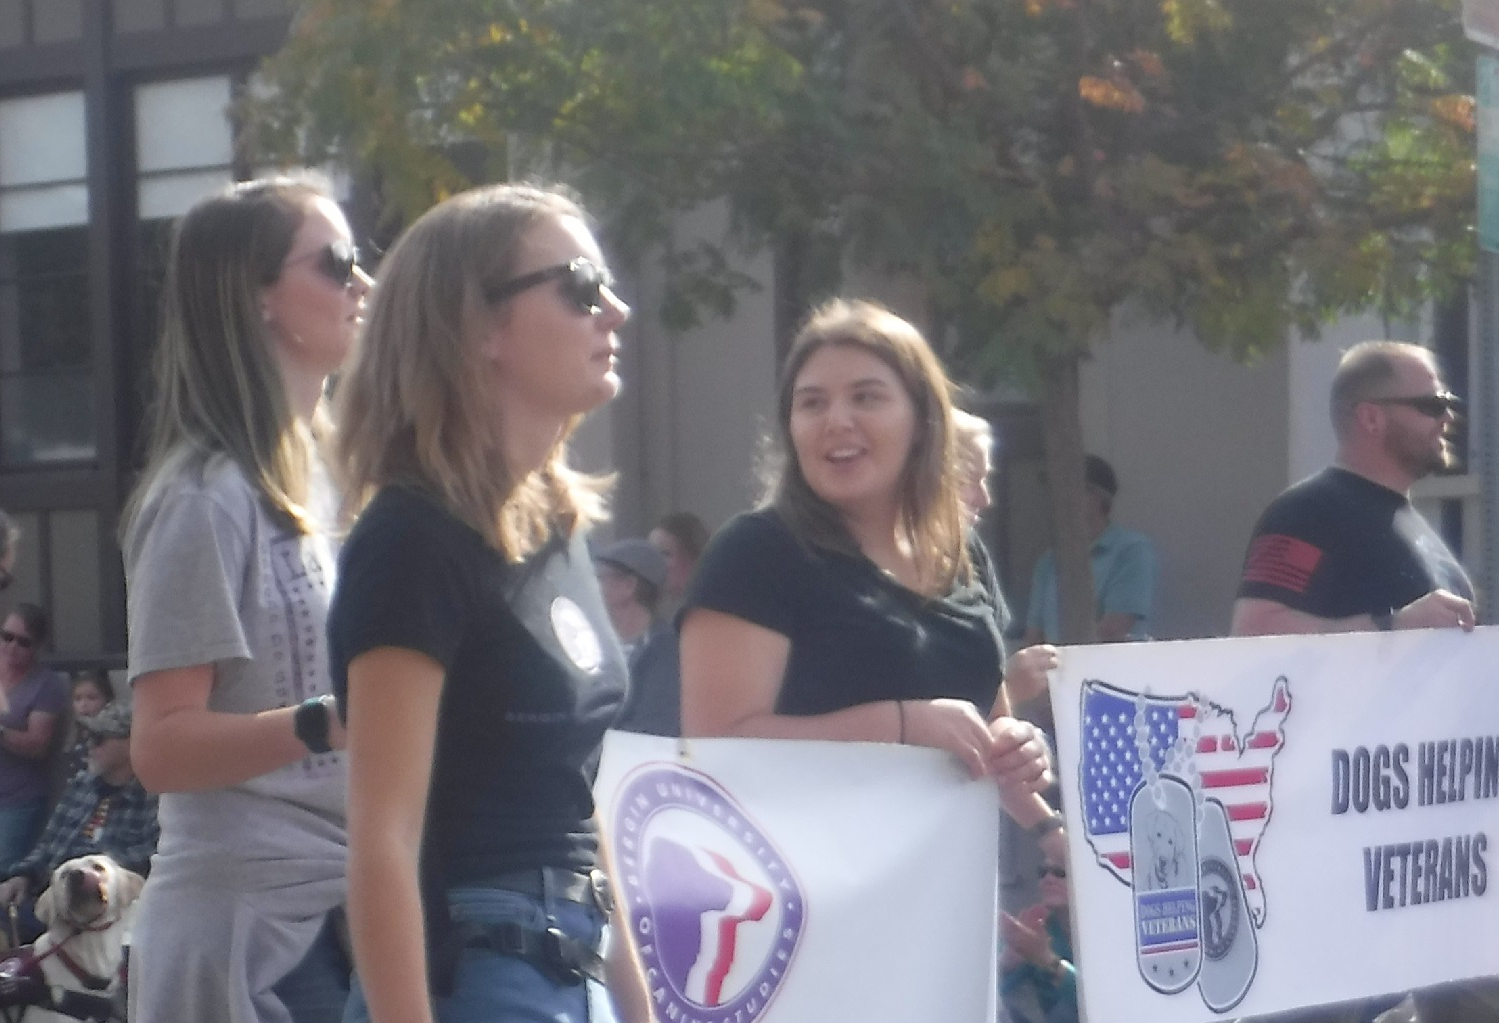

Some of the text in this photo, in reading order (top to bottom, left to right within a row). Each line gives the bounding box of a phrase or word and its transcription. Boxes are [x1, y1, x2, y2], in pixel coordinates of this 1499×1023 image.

[1331, 734, 1499, 815] DOGS HELPIN
[622, 782, 791, 888] BERGIN UNIVERSITY
[1363, 831, 1487, 912] VETERANS
[1141, 915, 1196, 935] VETERANS
